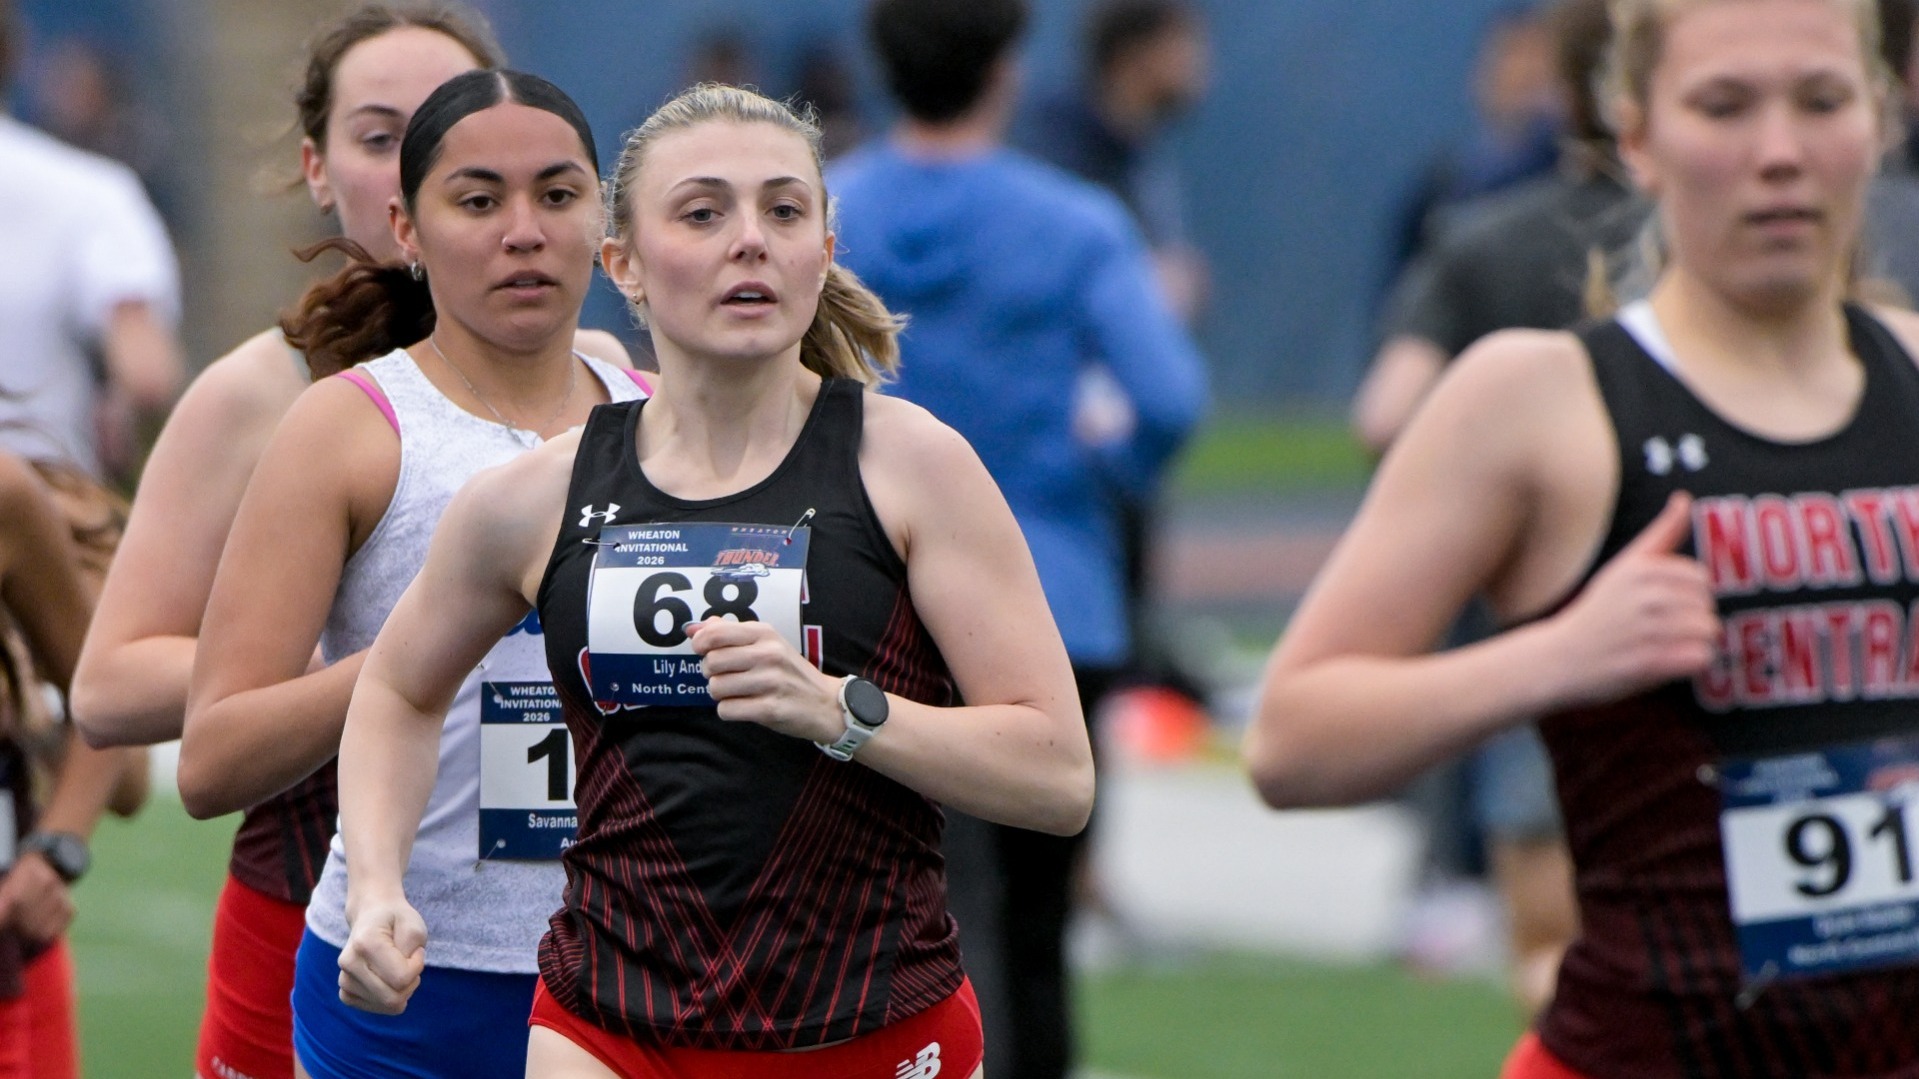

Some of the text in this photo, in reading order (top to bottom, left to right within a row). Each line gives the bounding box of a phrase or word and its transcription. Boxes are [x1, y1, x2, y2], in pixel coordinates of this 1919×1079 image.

[628, 530, 681, 540] WHEATON
[636, 556, 665, 566] 2026
[714, 549, 780, 567] THUNDER
[633, 571, 759, 648] 68
[653, 659, 675, 678] Lily
[510, 686, 558, 696] WHEATO
[632, 683, 672, 695] North
[500, 699, 562, 709] INVITATION
[523, 712, 551, 722] 2026
[527, 728, 568, 801] 1
[528, 813, 578, 829] Savanna
[1784, 803, 1913, 897] 91
